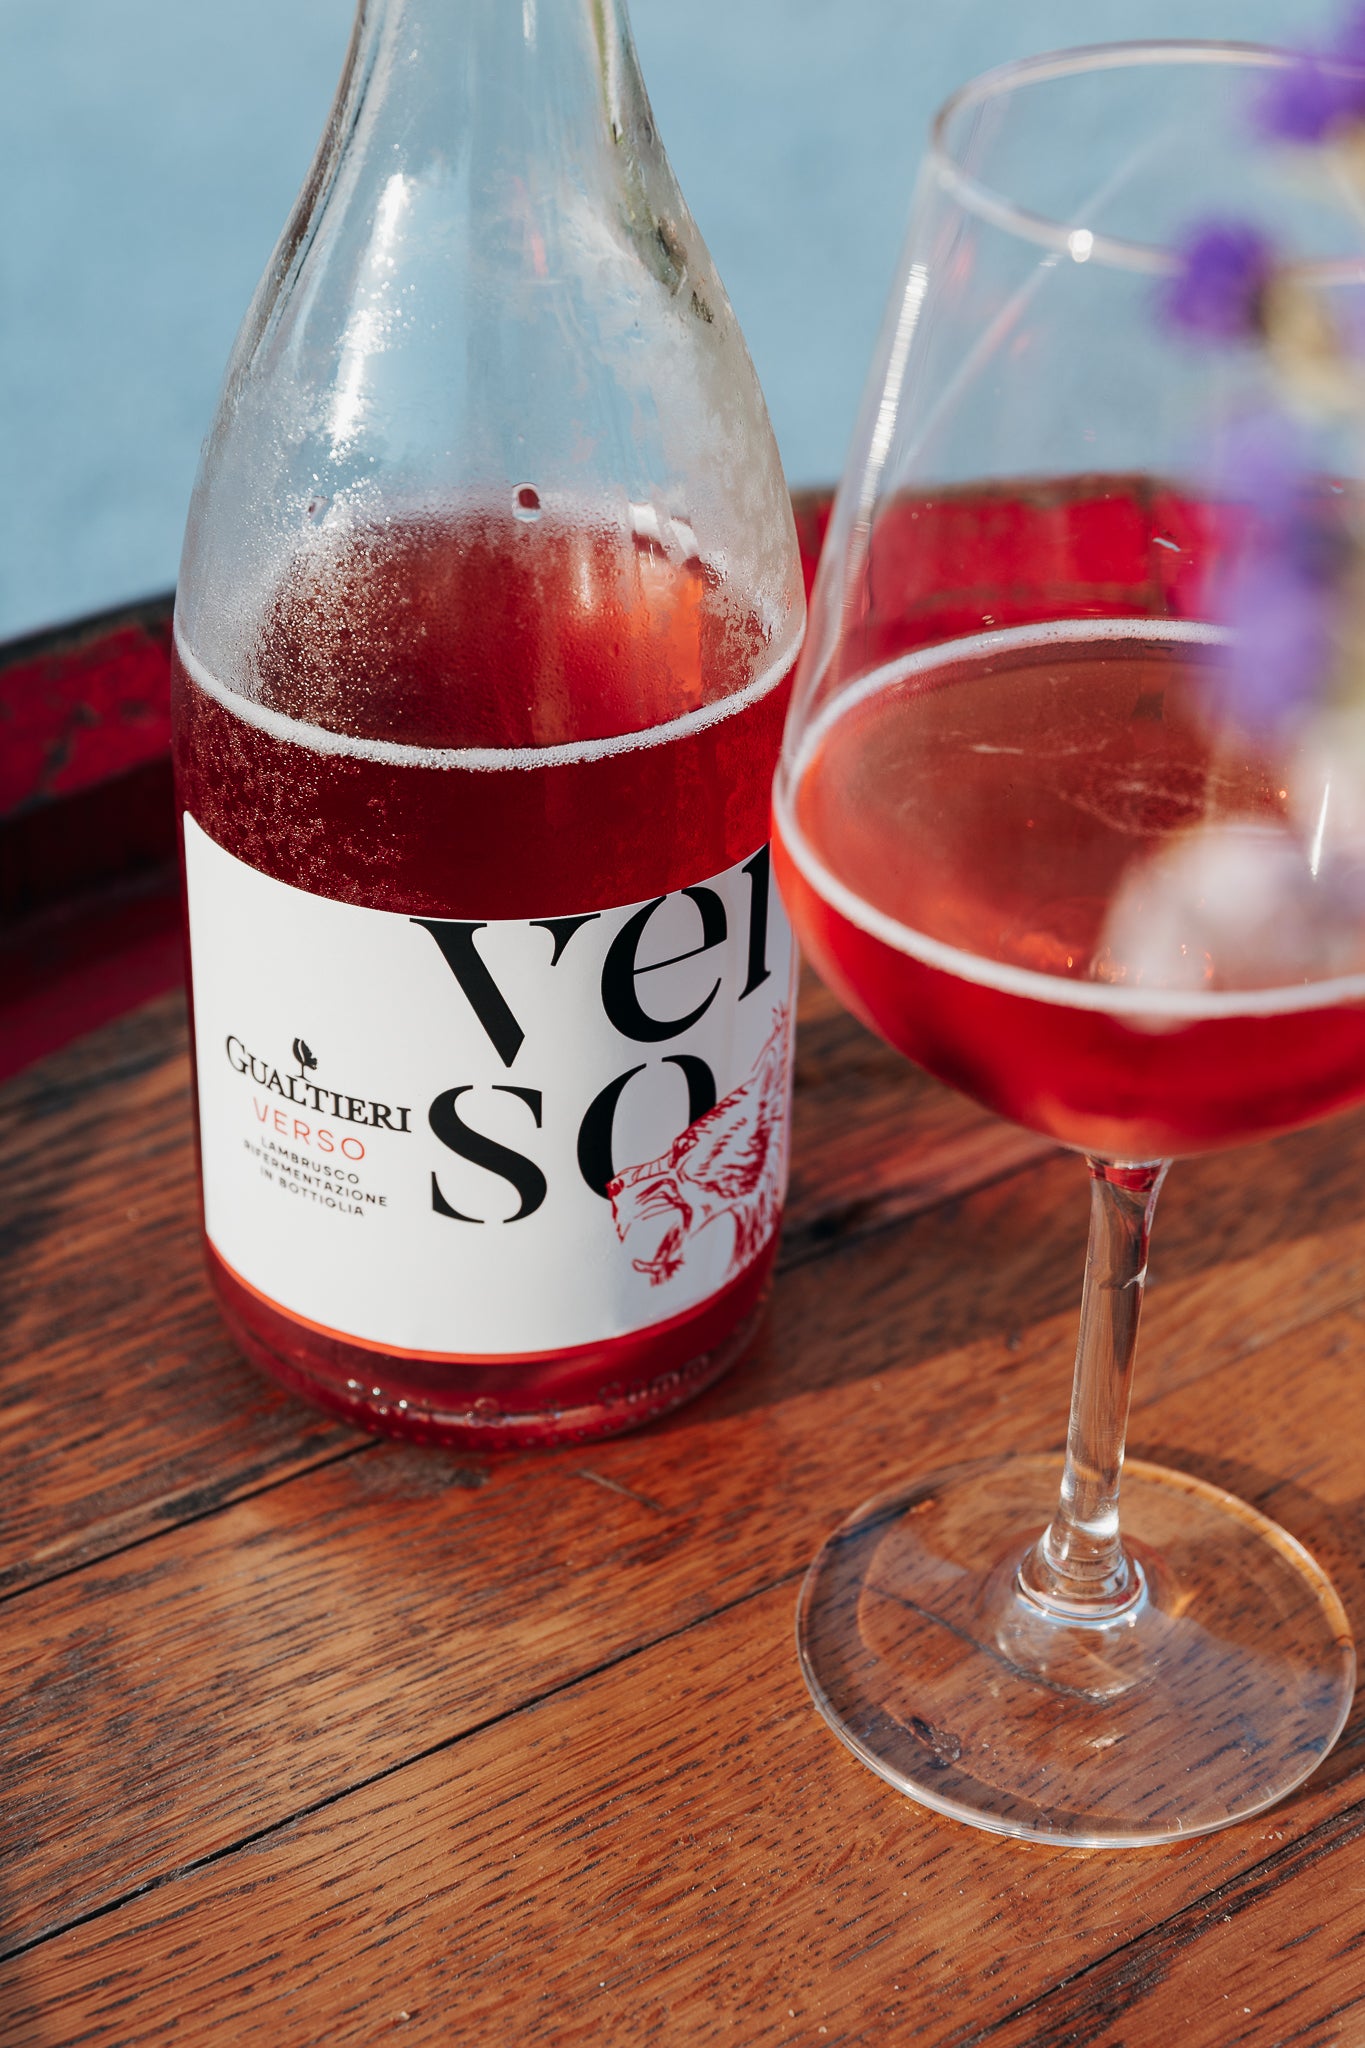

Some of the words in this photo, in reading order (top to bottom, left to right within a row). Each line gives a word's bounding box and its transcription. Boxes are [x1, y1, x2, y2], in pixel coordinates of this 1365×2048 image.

[226, 1035, 412, 1133] GUALTIERI
[253, 1097, 365, 1160] VERSO
[261, 1136, 360, 1185] LAMBRUSCO
[428, 1055, 717, 1224] so
[244, 1139, 388, 1207] RIFERMENTAZIONE
[260, 1167, 273, 1181] IN
[279, 1178, 364, 1217] BOTTIGLIA
